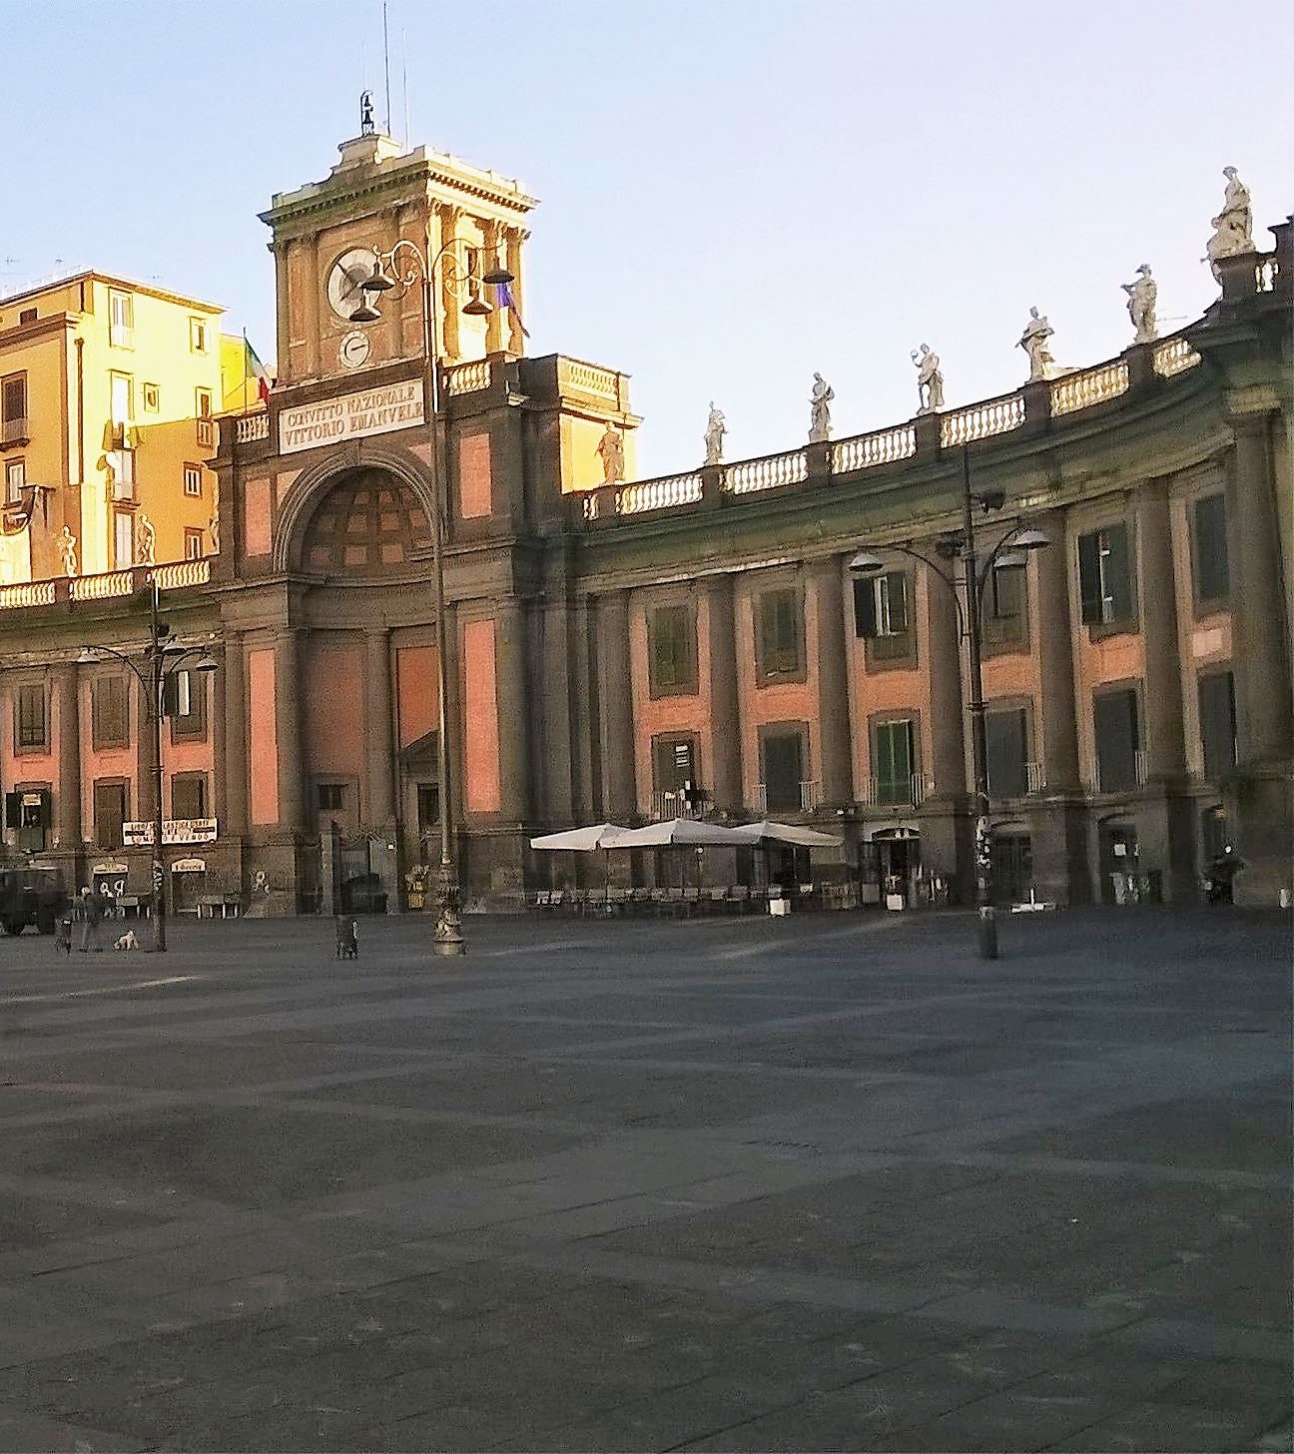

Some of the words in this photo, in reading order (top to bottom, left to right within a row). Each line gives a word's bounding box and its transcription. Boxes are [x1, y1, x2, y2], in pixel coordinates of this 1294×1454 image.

[288, 403, 343, 427] CONVITTO
[347, 386, 415, 413] NAZIONALE
[285, 420, 345, 445] VITTORIO
